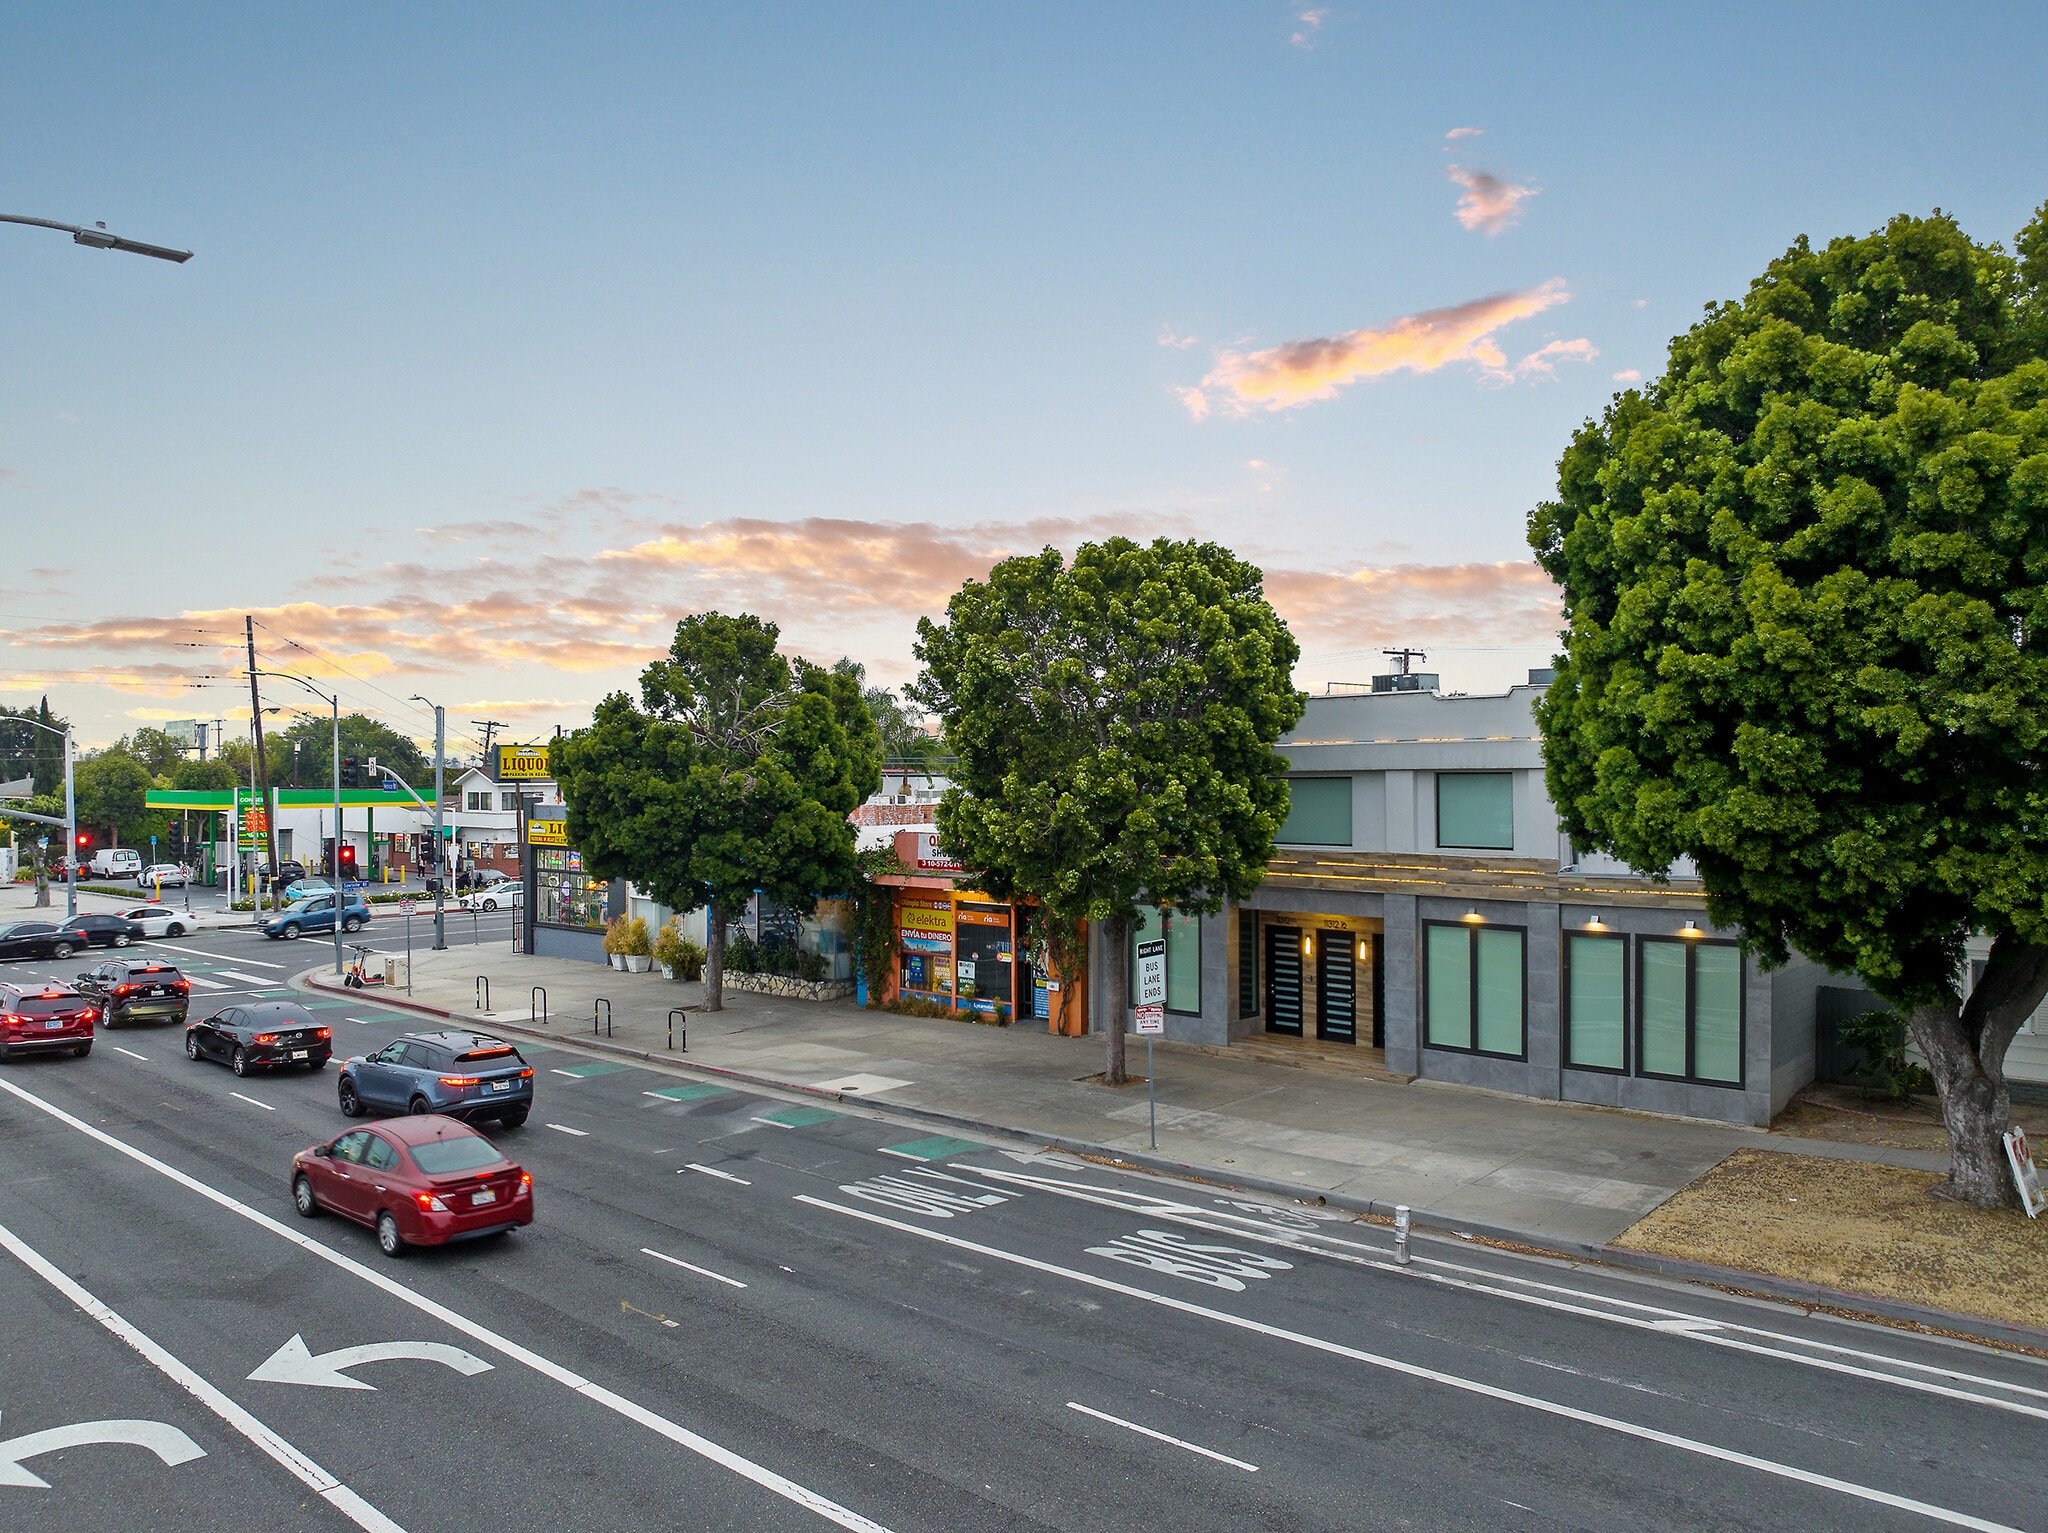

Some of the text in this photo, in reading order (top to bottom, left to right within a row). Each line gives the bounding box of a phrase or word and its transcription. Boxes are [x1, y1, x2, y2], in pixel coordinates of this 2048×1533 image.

[550, 824, 567, 834] LI
[929, 834, 940, 847] O
[916, 914, 946, 927] elektra
[901, 928, 920, 938] ENVÍA
[928, 933, 952, 942] DINERO
[1140, 945, 1163, 955] RIGHT LANE
[1146, 962, 1158, 972] BUS
[1144, 974, 1160, 985] LANE
[1144, 987, 1161, 998] ENDS
[838, 1166, 1024, 1218] ONLY
[1083, 1229, 1294, 1292] BUS
